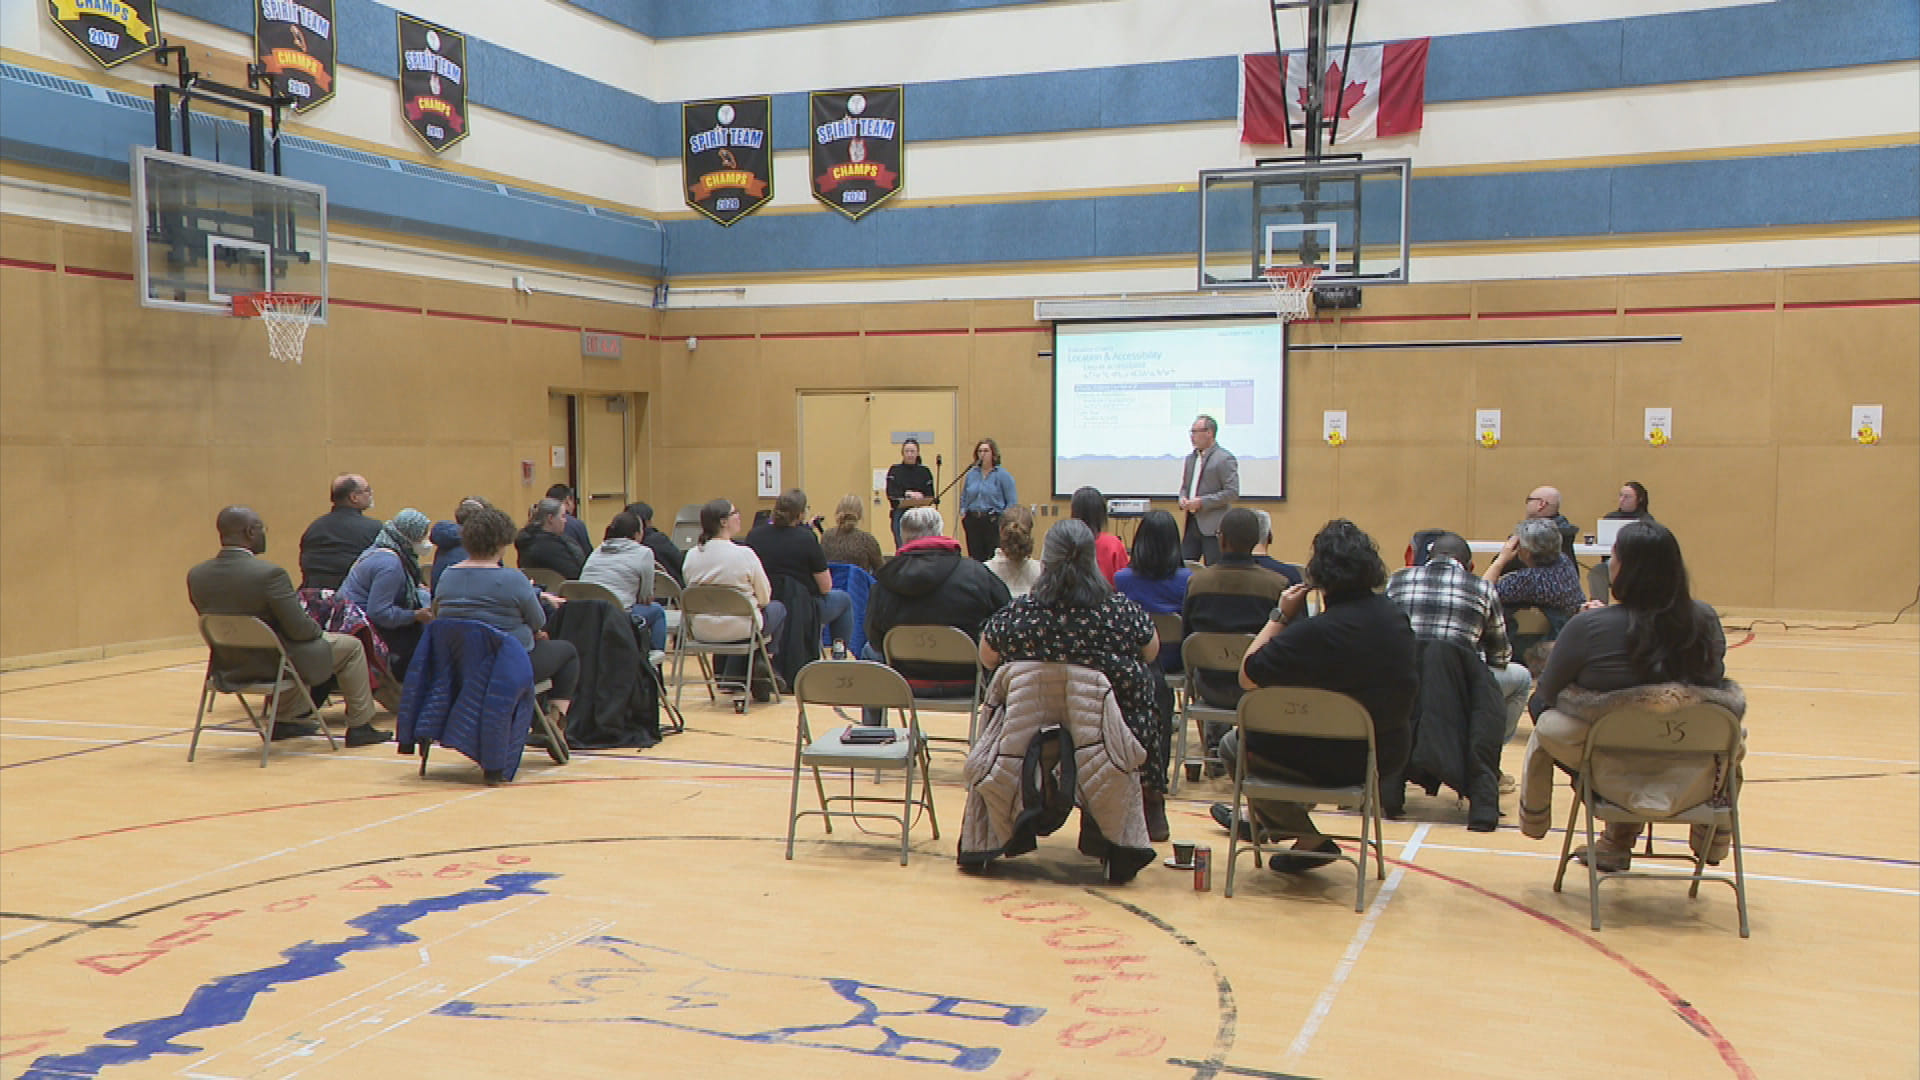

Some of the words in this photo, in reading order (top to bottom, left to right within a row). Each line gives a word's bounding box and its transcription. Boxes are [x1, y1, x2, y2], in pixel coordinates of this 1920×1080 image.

[299, 6, 331, 39] TEAM
[88, 27, 120, 49] 2017
[277, 51, 318, 73] CHAMPS
[437, 56, 461, 84] TEAM
[418, 97, 451, 117] CHAMPS
[690, 126, 729, 153] SPIRIT
[729, 127, 764, 149] TEAM
[816, 117, 858, 145] SPIRIT
[859, 117, 896, 140] TEAM
[705, 171, 748, 189] CHAMPS
[832, 164, 878, 180] CHAMPS
[1657, 719, 1689, 745] JS
